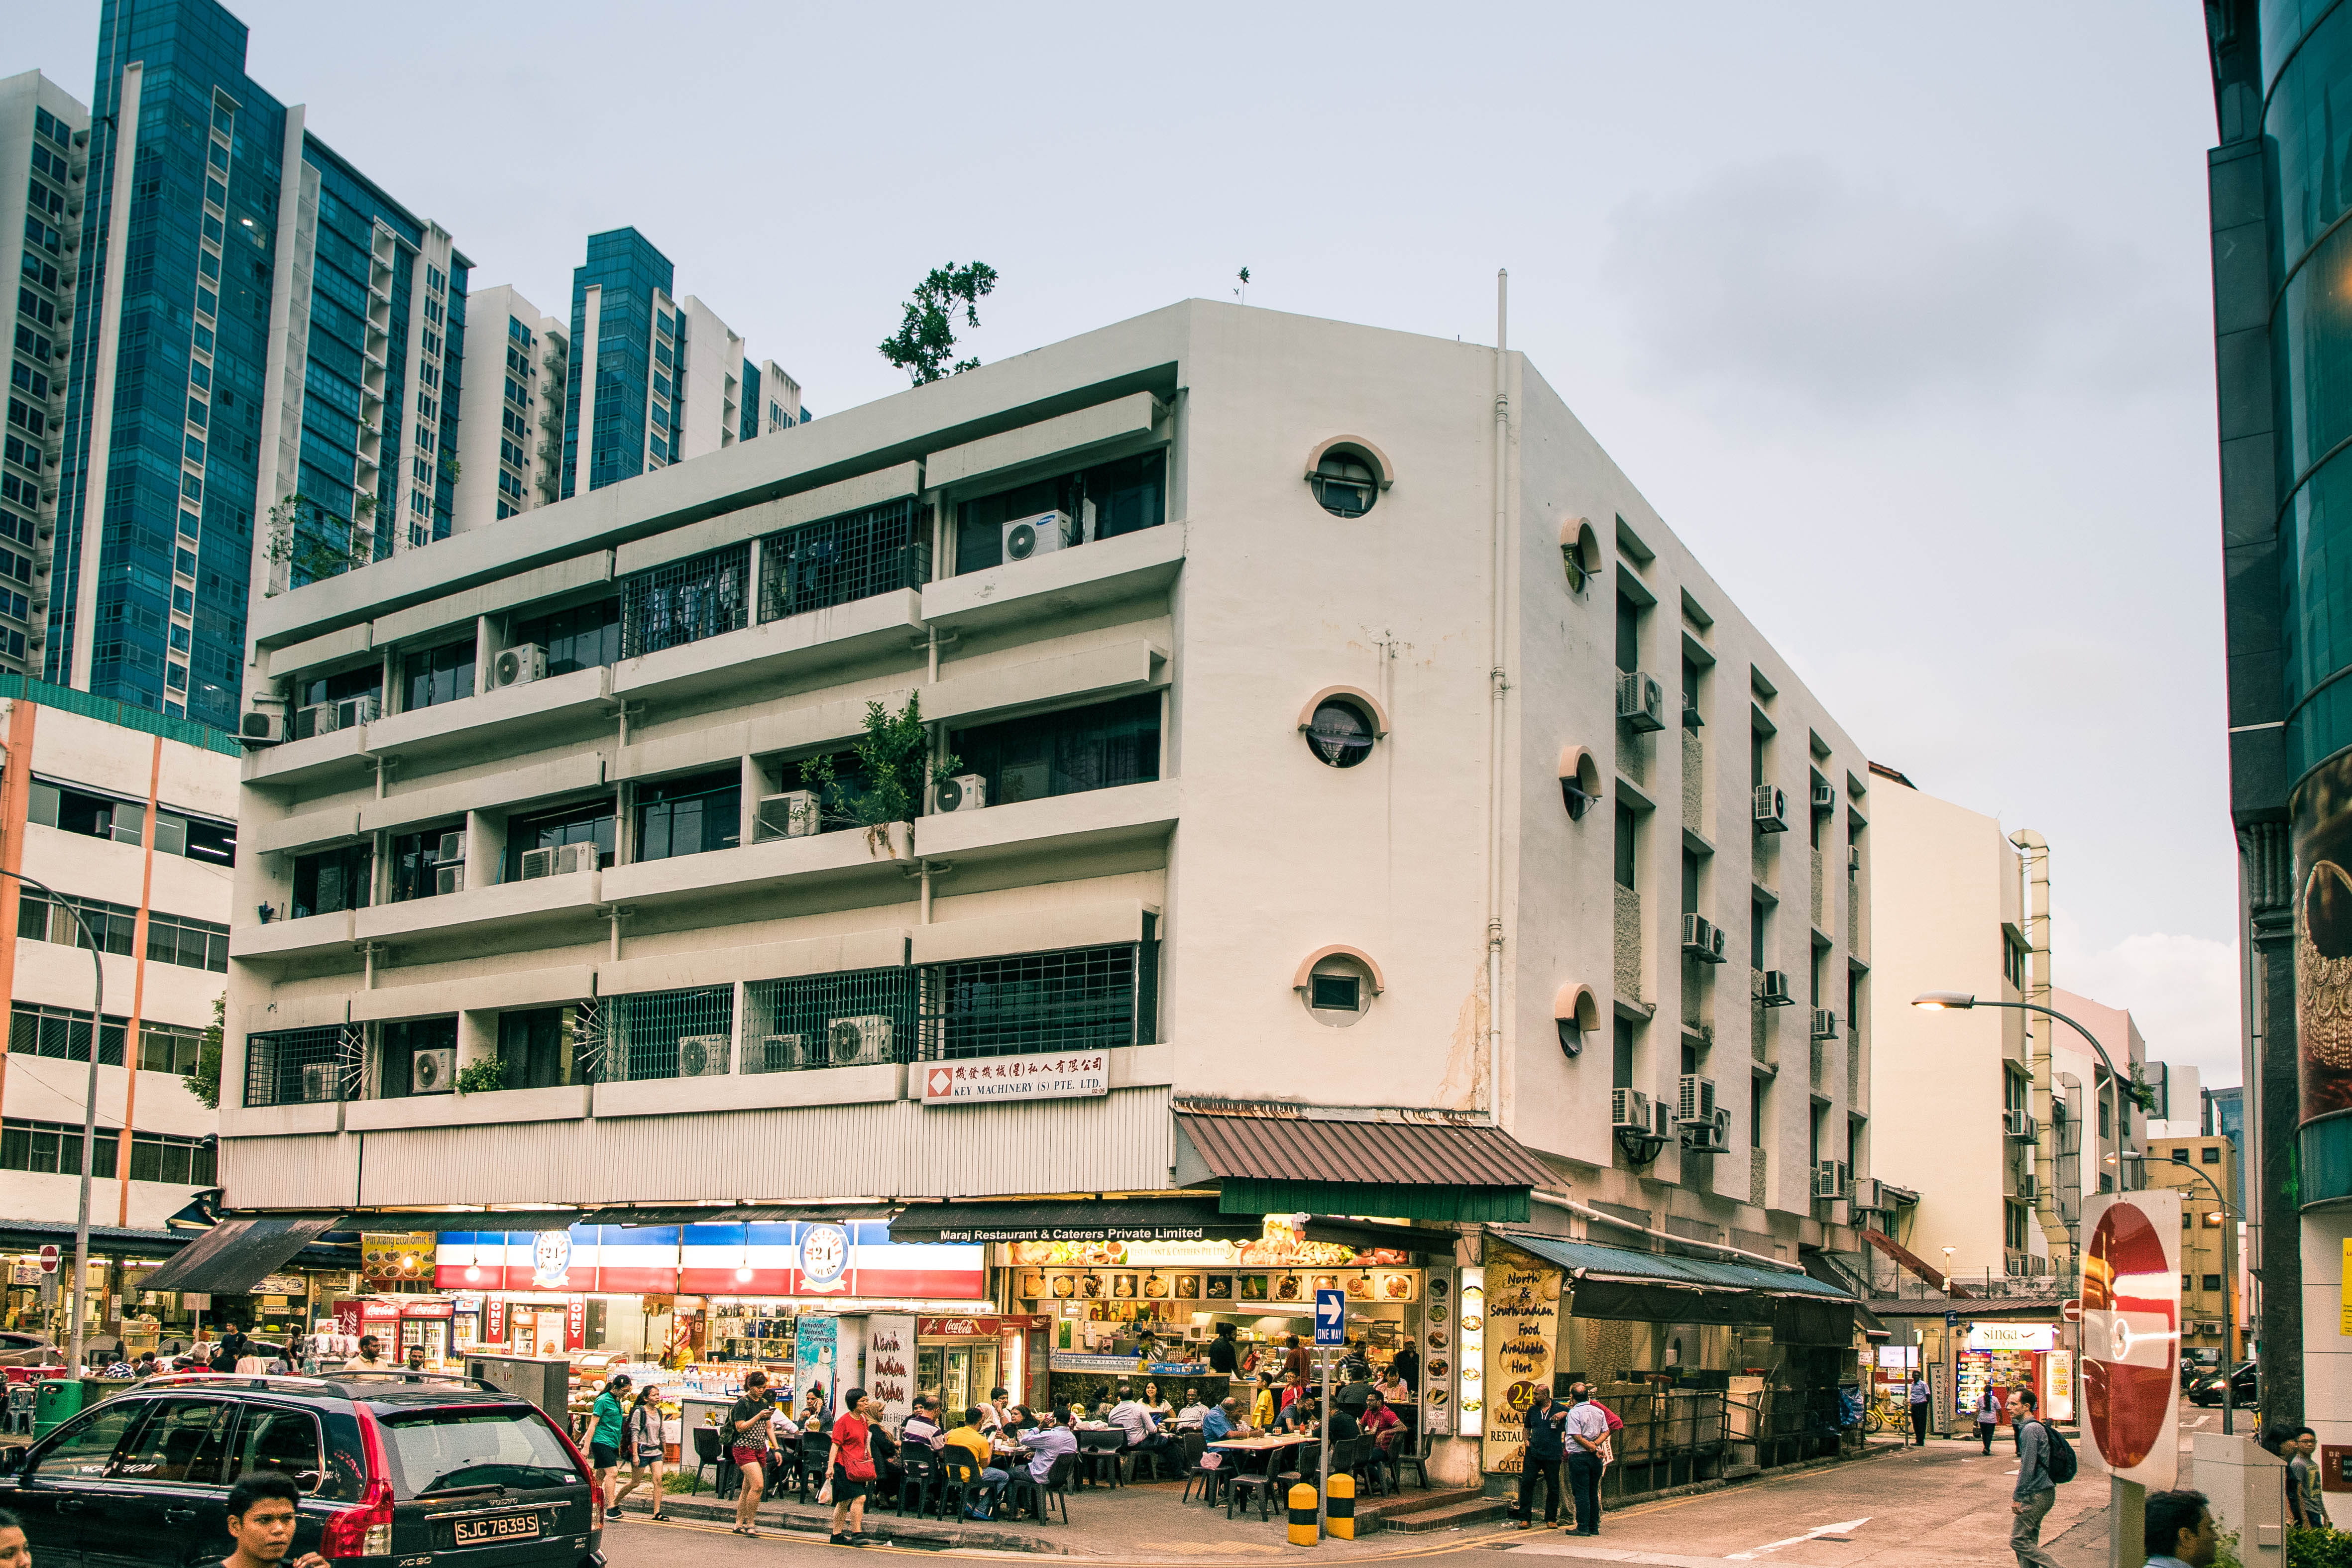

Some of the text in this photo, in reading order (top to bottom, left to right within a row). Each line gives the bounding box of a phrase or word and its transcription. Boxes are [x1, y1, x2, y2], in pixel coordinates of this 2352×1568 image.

[954, 1079, 1101, 1096] KEY MACHINERY (S) PTE. LTD.
[940, 1228, 1202, 1241] Maraj Restaurant & Caterers Private Limited
[1508, 1272, 1540, 1284] North
[1520, 1287, 1531, 1299] &
[490, 1295, 501, 1336] MONEY
[570, 1295, 582, 1338] MONEY
[1318, 1329, 1342, 1340] ONE WAY
[1518, 1322, 1541, 1336] Food
[1500, 1341, 1545, 1355] Available
[1511, 1359, 1533, 1373] Here
[1513, 1384, 1535, 1404] 24
[1518, 1446, 1525, 1457] &
[457, 1516, 537, 1539] SJC7839S
